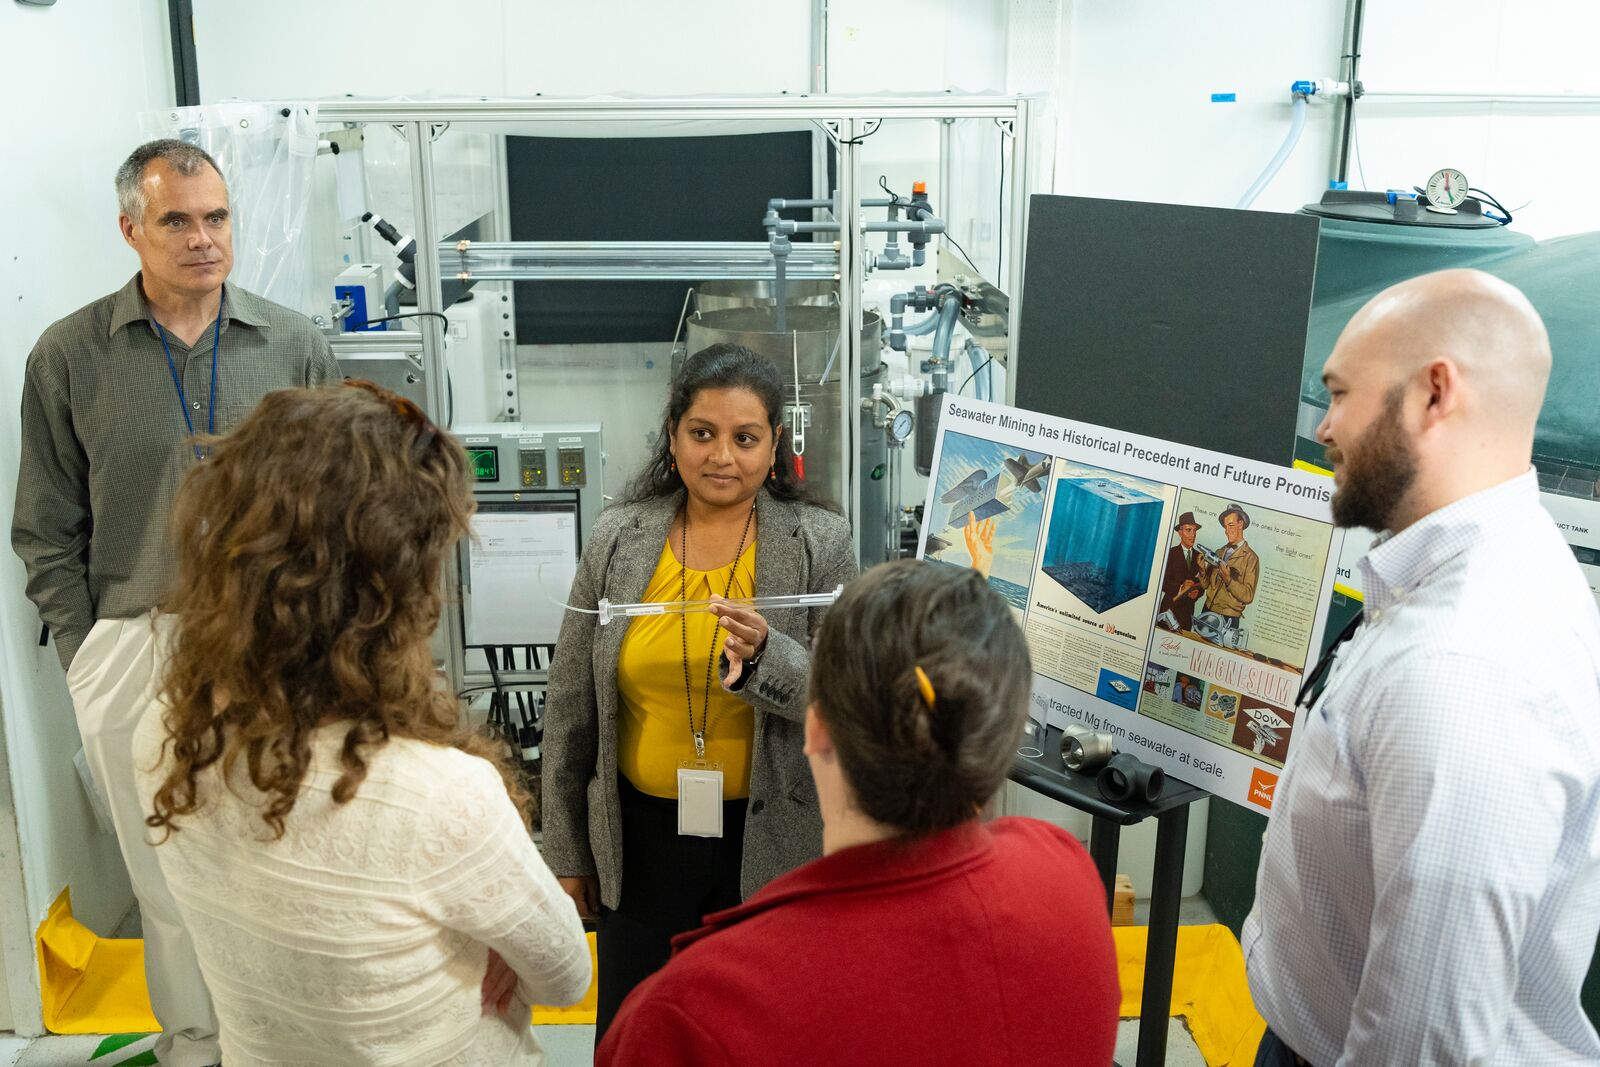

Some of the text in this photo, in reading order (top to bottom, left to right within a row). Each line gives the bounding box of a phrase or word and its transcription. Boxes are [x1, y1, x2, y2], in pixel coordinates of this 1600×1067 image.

[948, 403, 1331, 502] Seawater Mining has Historical Precedent and Future Promis
[1260, 523, 1273, 531] ones
[1556, 522, 1589, 534] UCT TANK
[1275, 544, 1284, 552] the
[1336, 567, 1351, 579] ard
[1059, 609, 1081, 622] unlimited
[1189, 647, 1293, 703] MAGNESIUM
[1254, 710, 1282, 727] DOW
[1041, 695, 1083, 720] tracted
[1084, 711, 1101, 730] Mg
[1102, 717, 1126, 738] from
[1127, 731, 1177, 758] seawater
[1179, 751, 1191, 765] at
[1192, 758, 1226, 779] scale.
[1253, 789, 1273, 802] PNNL
